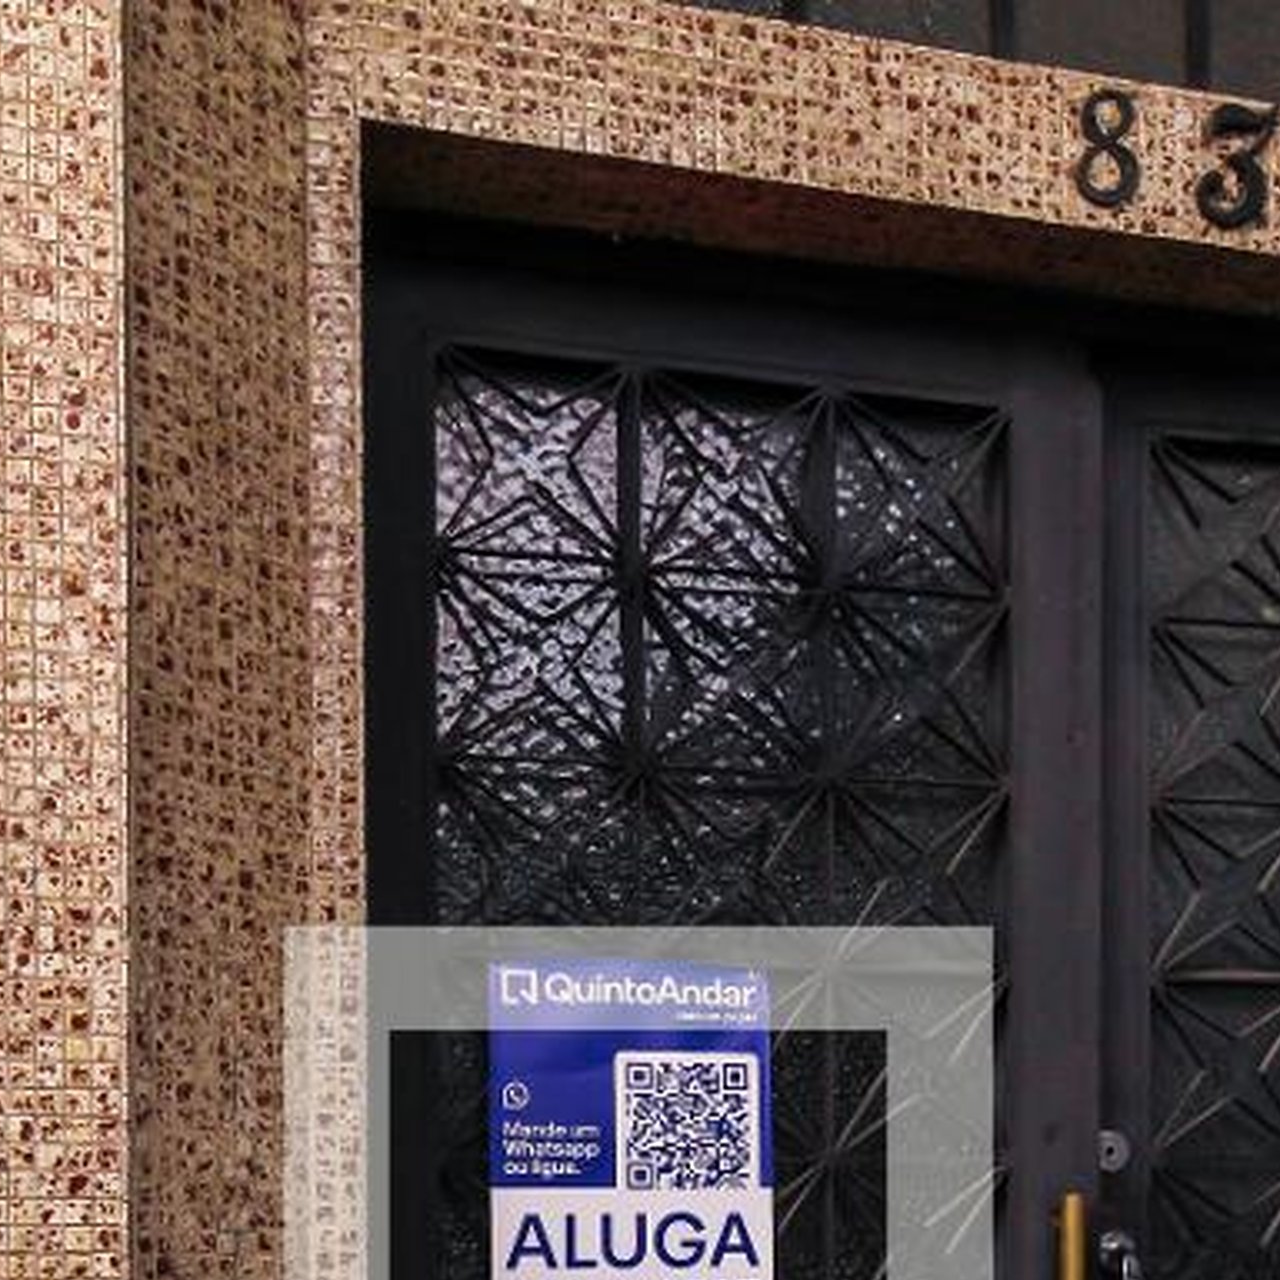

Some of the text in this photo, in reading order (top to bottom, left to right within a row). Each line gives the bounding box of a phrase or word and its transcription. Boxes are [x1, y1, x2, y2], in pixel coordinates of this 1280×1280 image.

[1077, 88, 1280, 229] 83
[545, 971, 757, 1007] QuintoAndar
[506, 1212, 759, 1270] ALUGA
